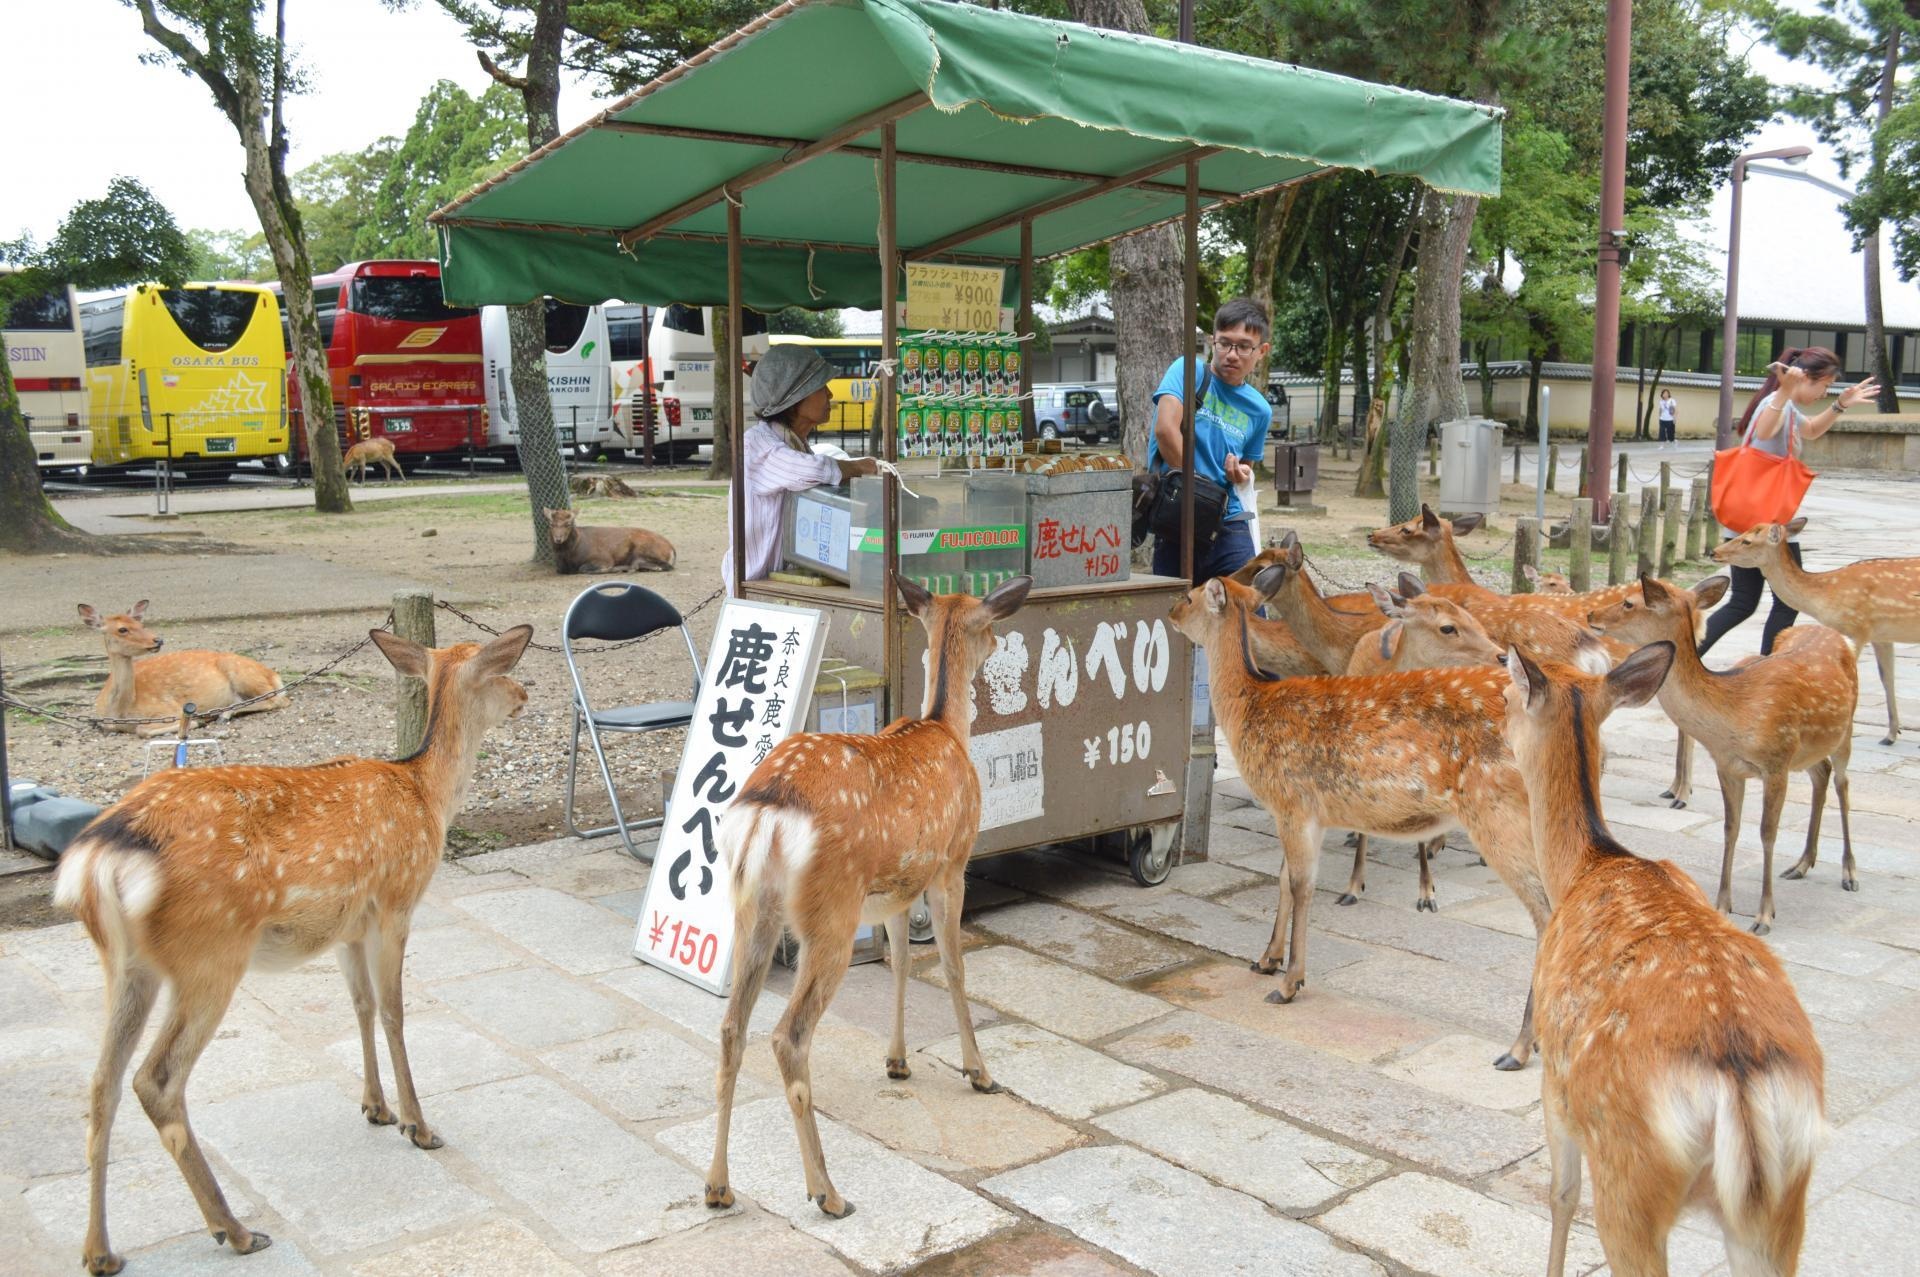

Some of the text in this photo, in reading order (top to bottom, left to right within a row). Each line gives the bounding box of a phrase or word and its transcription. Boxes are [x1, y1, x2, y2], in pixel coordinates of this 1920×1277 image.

[908, 266, 1000, 282] フラッシュ付カメラ
[172, 356, 259, 366] OSAKA BUS
[909, 528, 1020, 548] FUJIFILM FUJICOLOR
[1084, 553, 1119, 577] ¥150
[1083, 720, 1151, 769] ¥150
[668, 622, 778, 902] 鹿せんべい
[649, 910, 718, 975] ¥150
